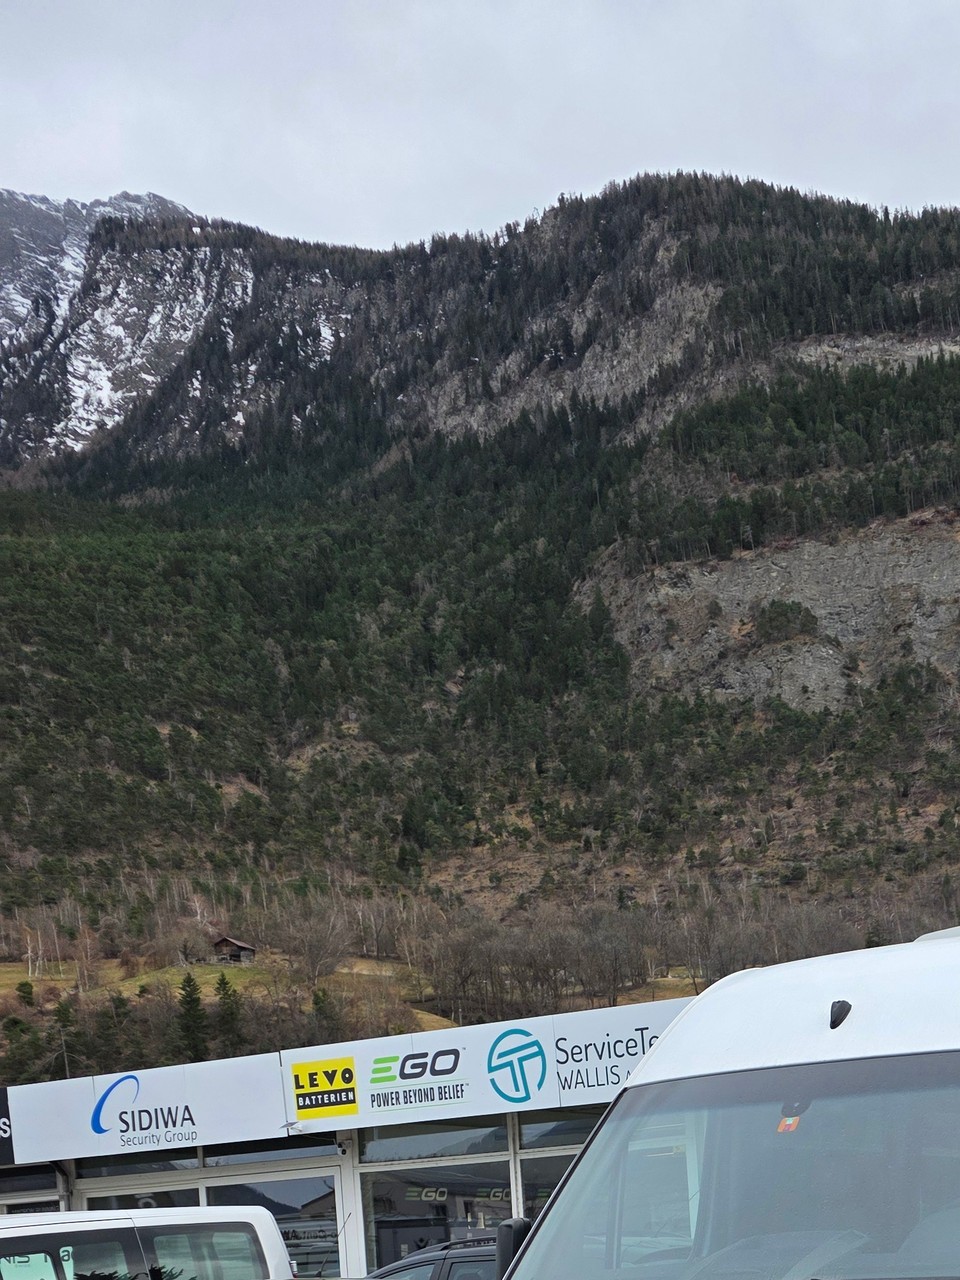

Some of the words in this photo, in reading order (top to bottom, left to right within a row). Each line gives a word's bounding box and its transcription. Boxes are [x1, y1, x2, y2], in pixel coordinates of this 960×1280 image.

[370, 1048, 460, 1084] EGO
[557, 1065, 621, 1090] WALLIS
[294, 1067, 354, 1089] LEVO
[299, 1091, 354, 1106] BATTERIEN
[371, 1091, 400, 1108] POWER
[403, 1087, 435, 1105] BEYOND
[438, 1083, 465, 1101] BELIEF
[118, 1105, 196, 1133] SIDIWA
[120, 1133, 161, 1147] Security
[164, 1130, 198, 1145] Group
[406, 1187, 448, 1201] EGO
